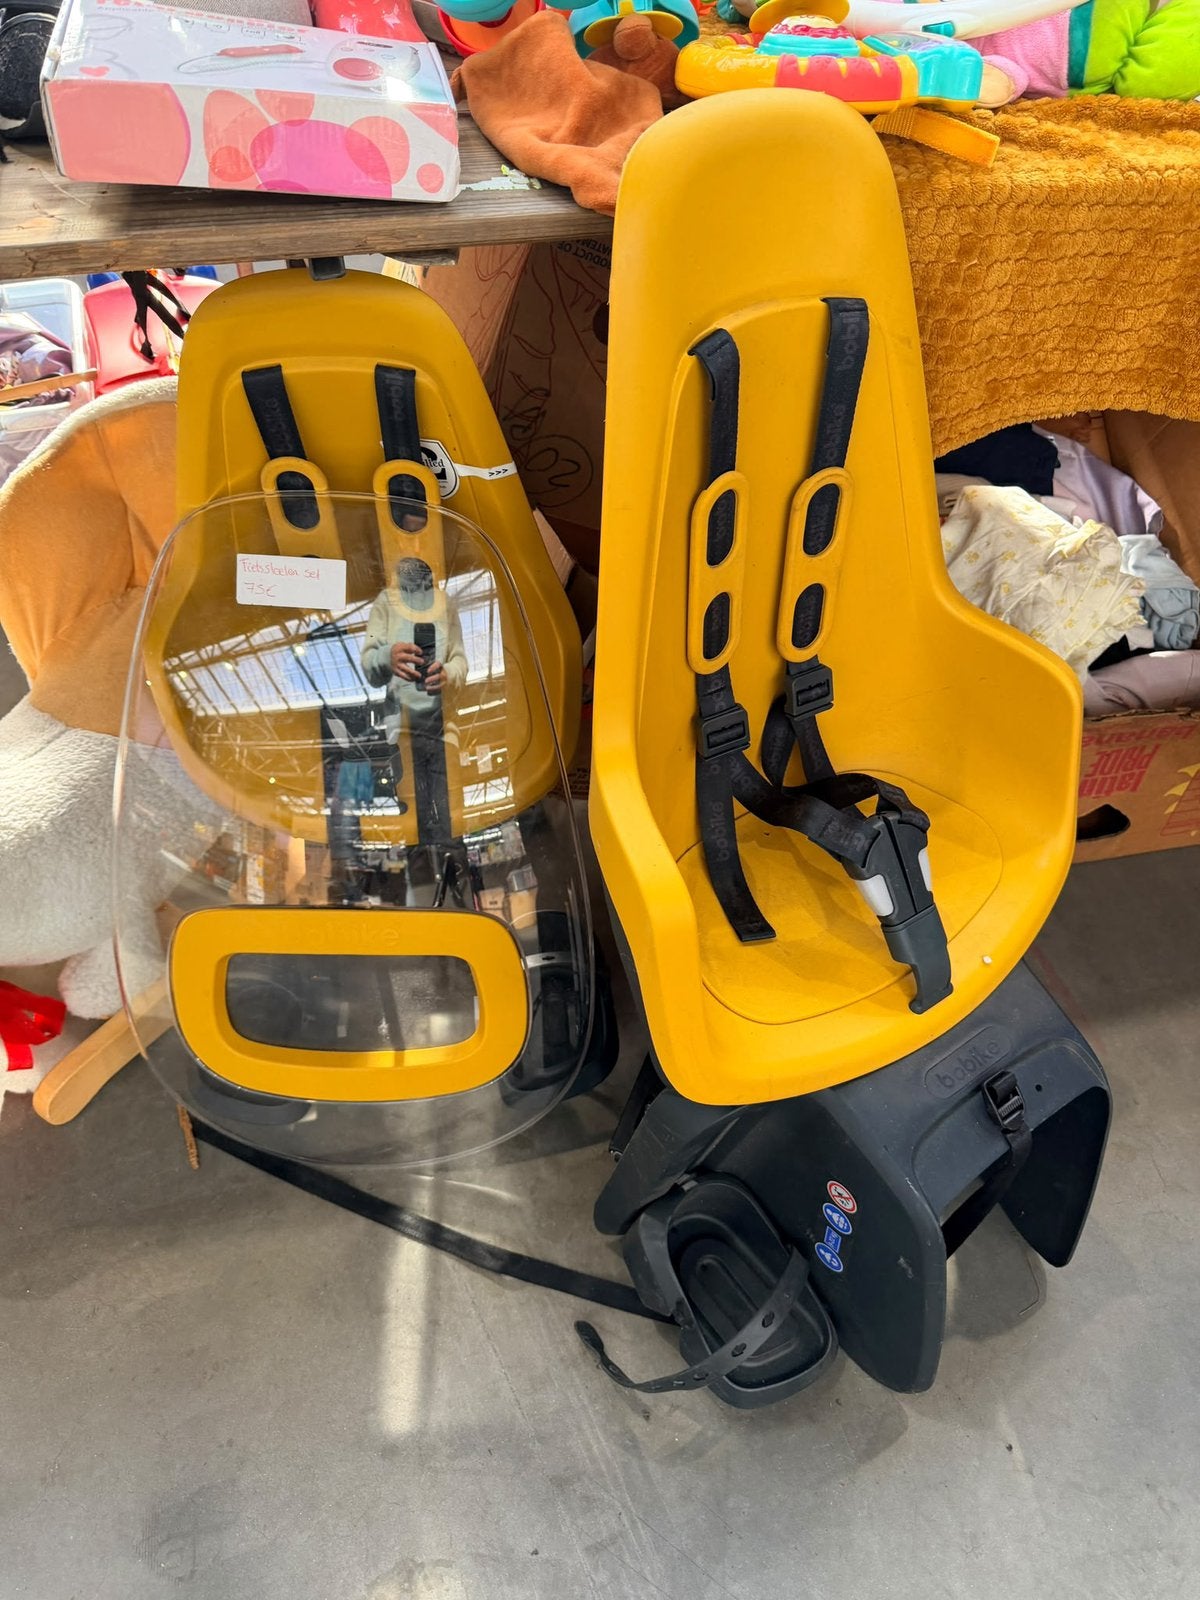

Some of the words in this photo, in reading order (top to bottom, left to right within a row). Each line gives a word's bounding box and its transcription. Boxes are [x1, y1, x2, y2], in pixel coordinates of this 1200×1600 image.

[1083, 743, 1162, 778] PRIDE
[708, 800, 730, 862] bobike
[934, 1041, 1000, 1088] bobike
